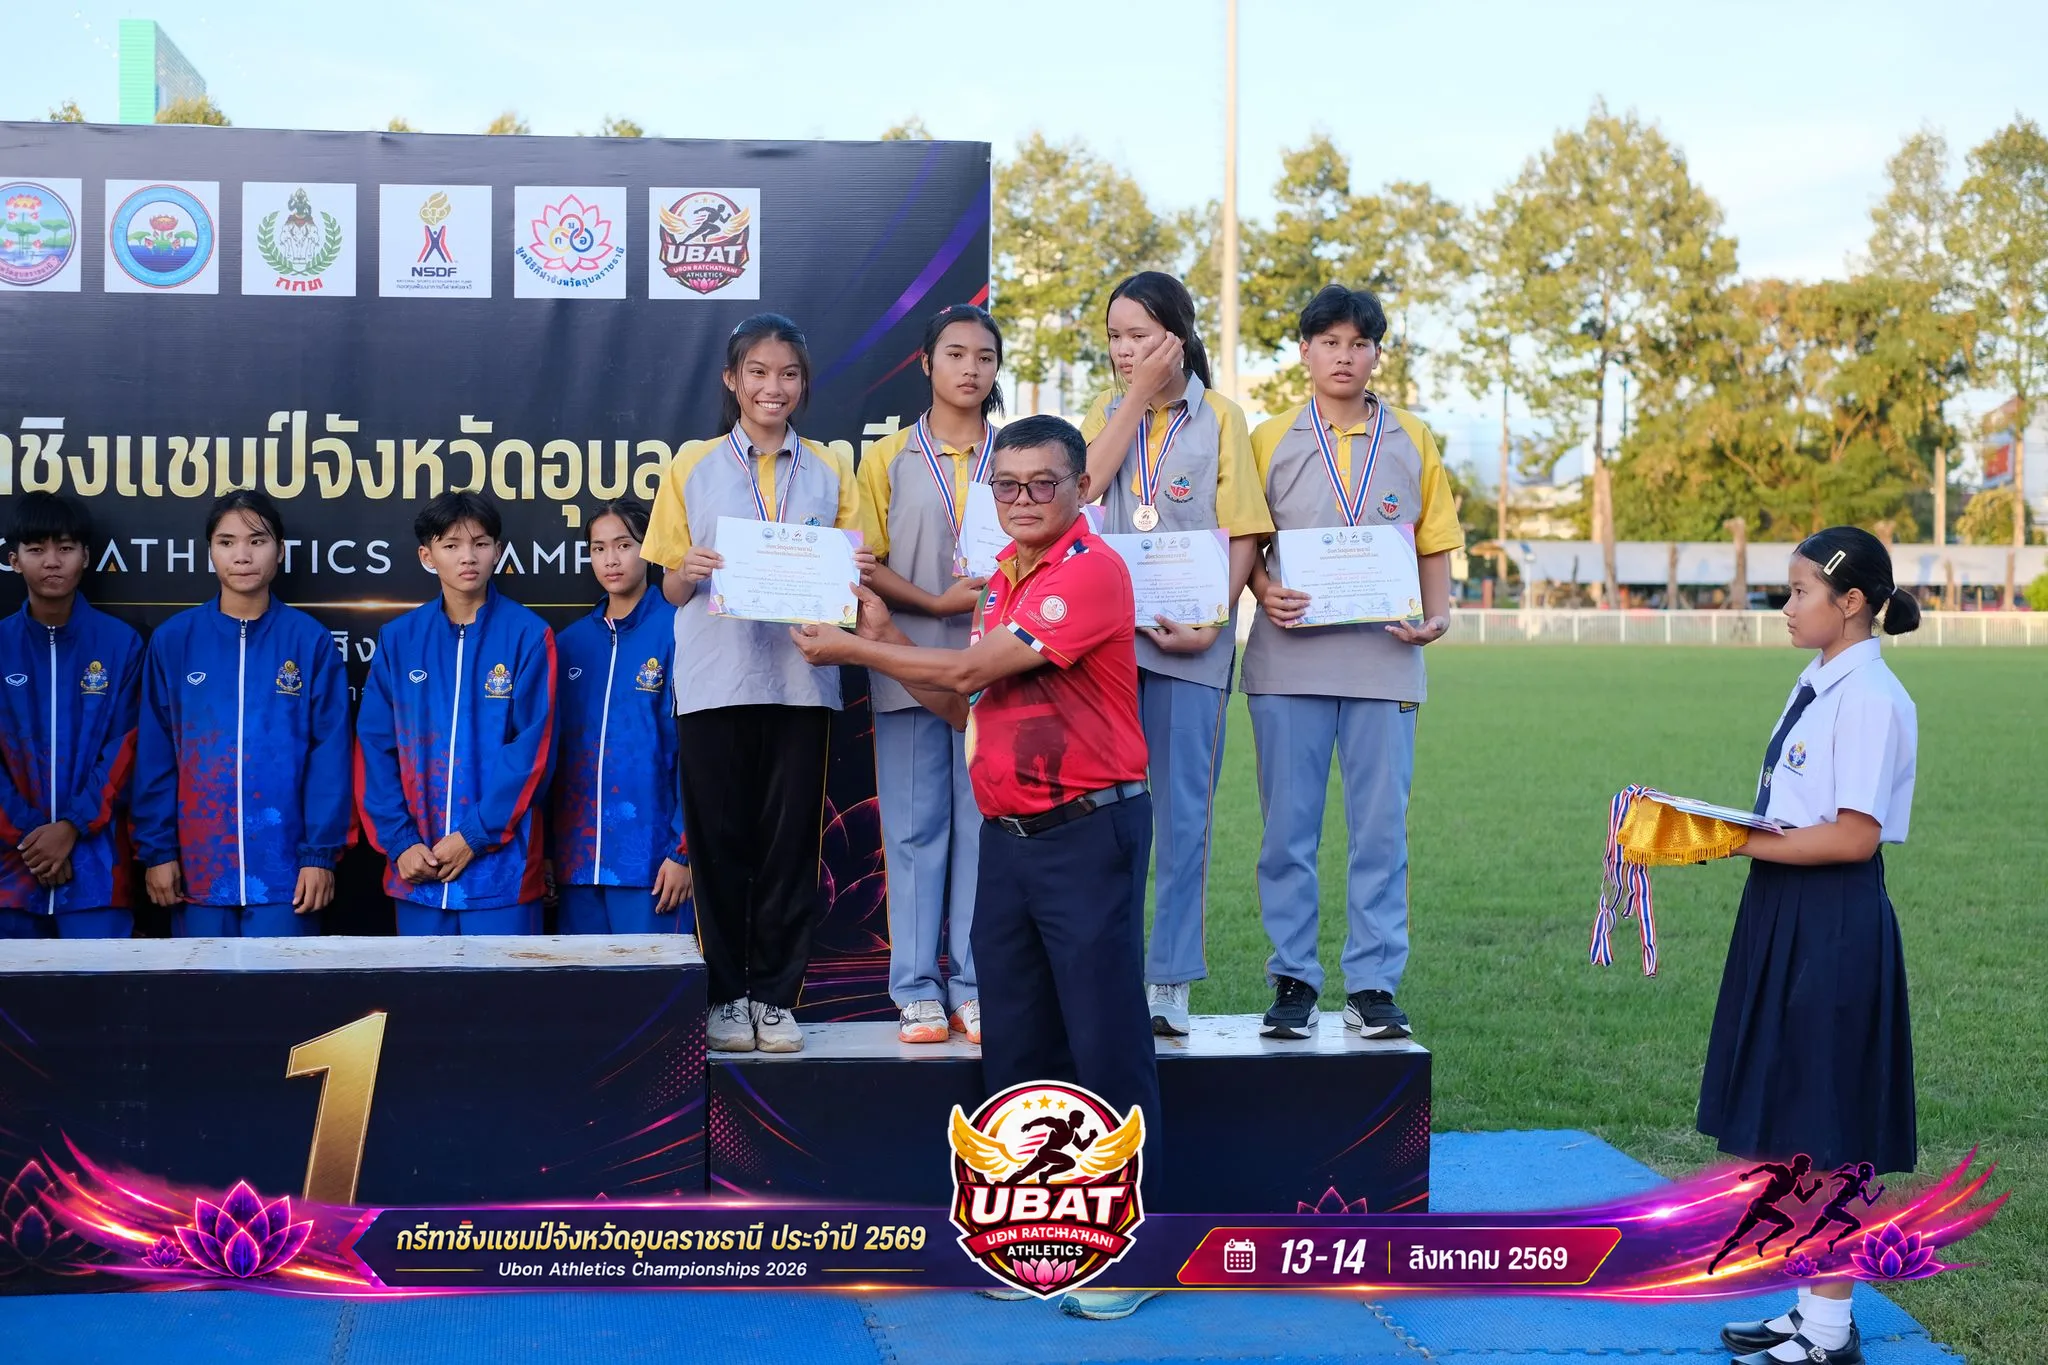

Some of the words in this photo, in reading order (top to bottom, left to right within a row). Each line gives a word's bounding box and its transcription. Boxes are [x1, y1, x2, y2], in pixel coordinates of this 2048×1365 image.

[666, 245, 743, 264] UBAT
[411, 267, 457, 277] NSDF
[275, 277, 323, 292] กกท
[96, 538, 392, 574] ATHTICS
[286, 1012, 388, 1205] 1
